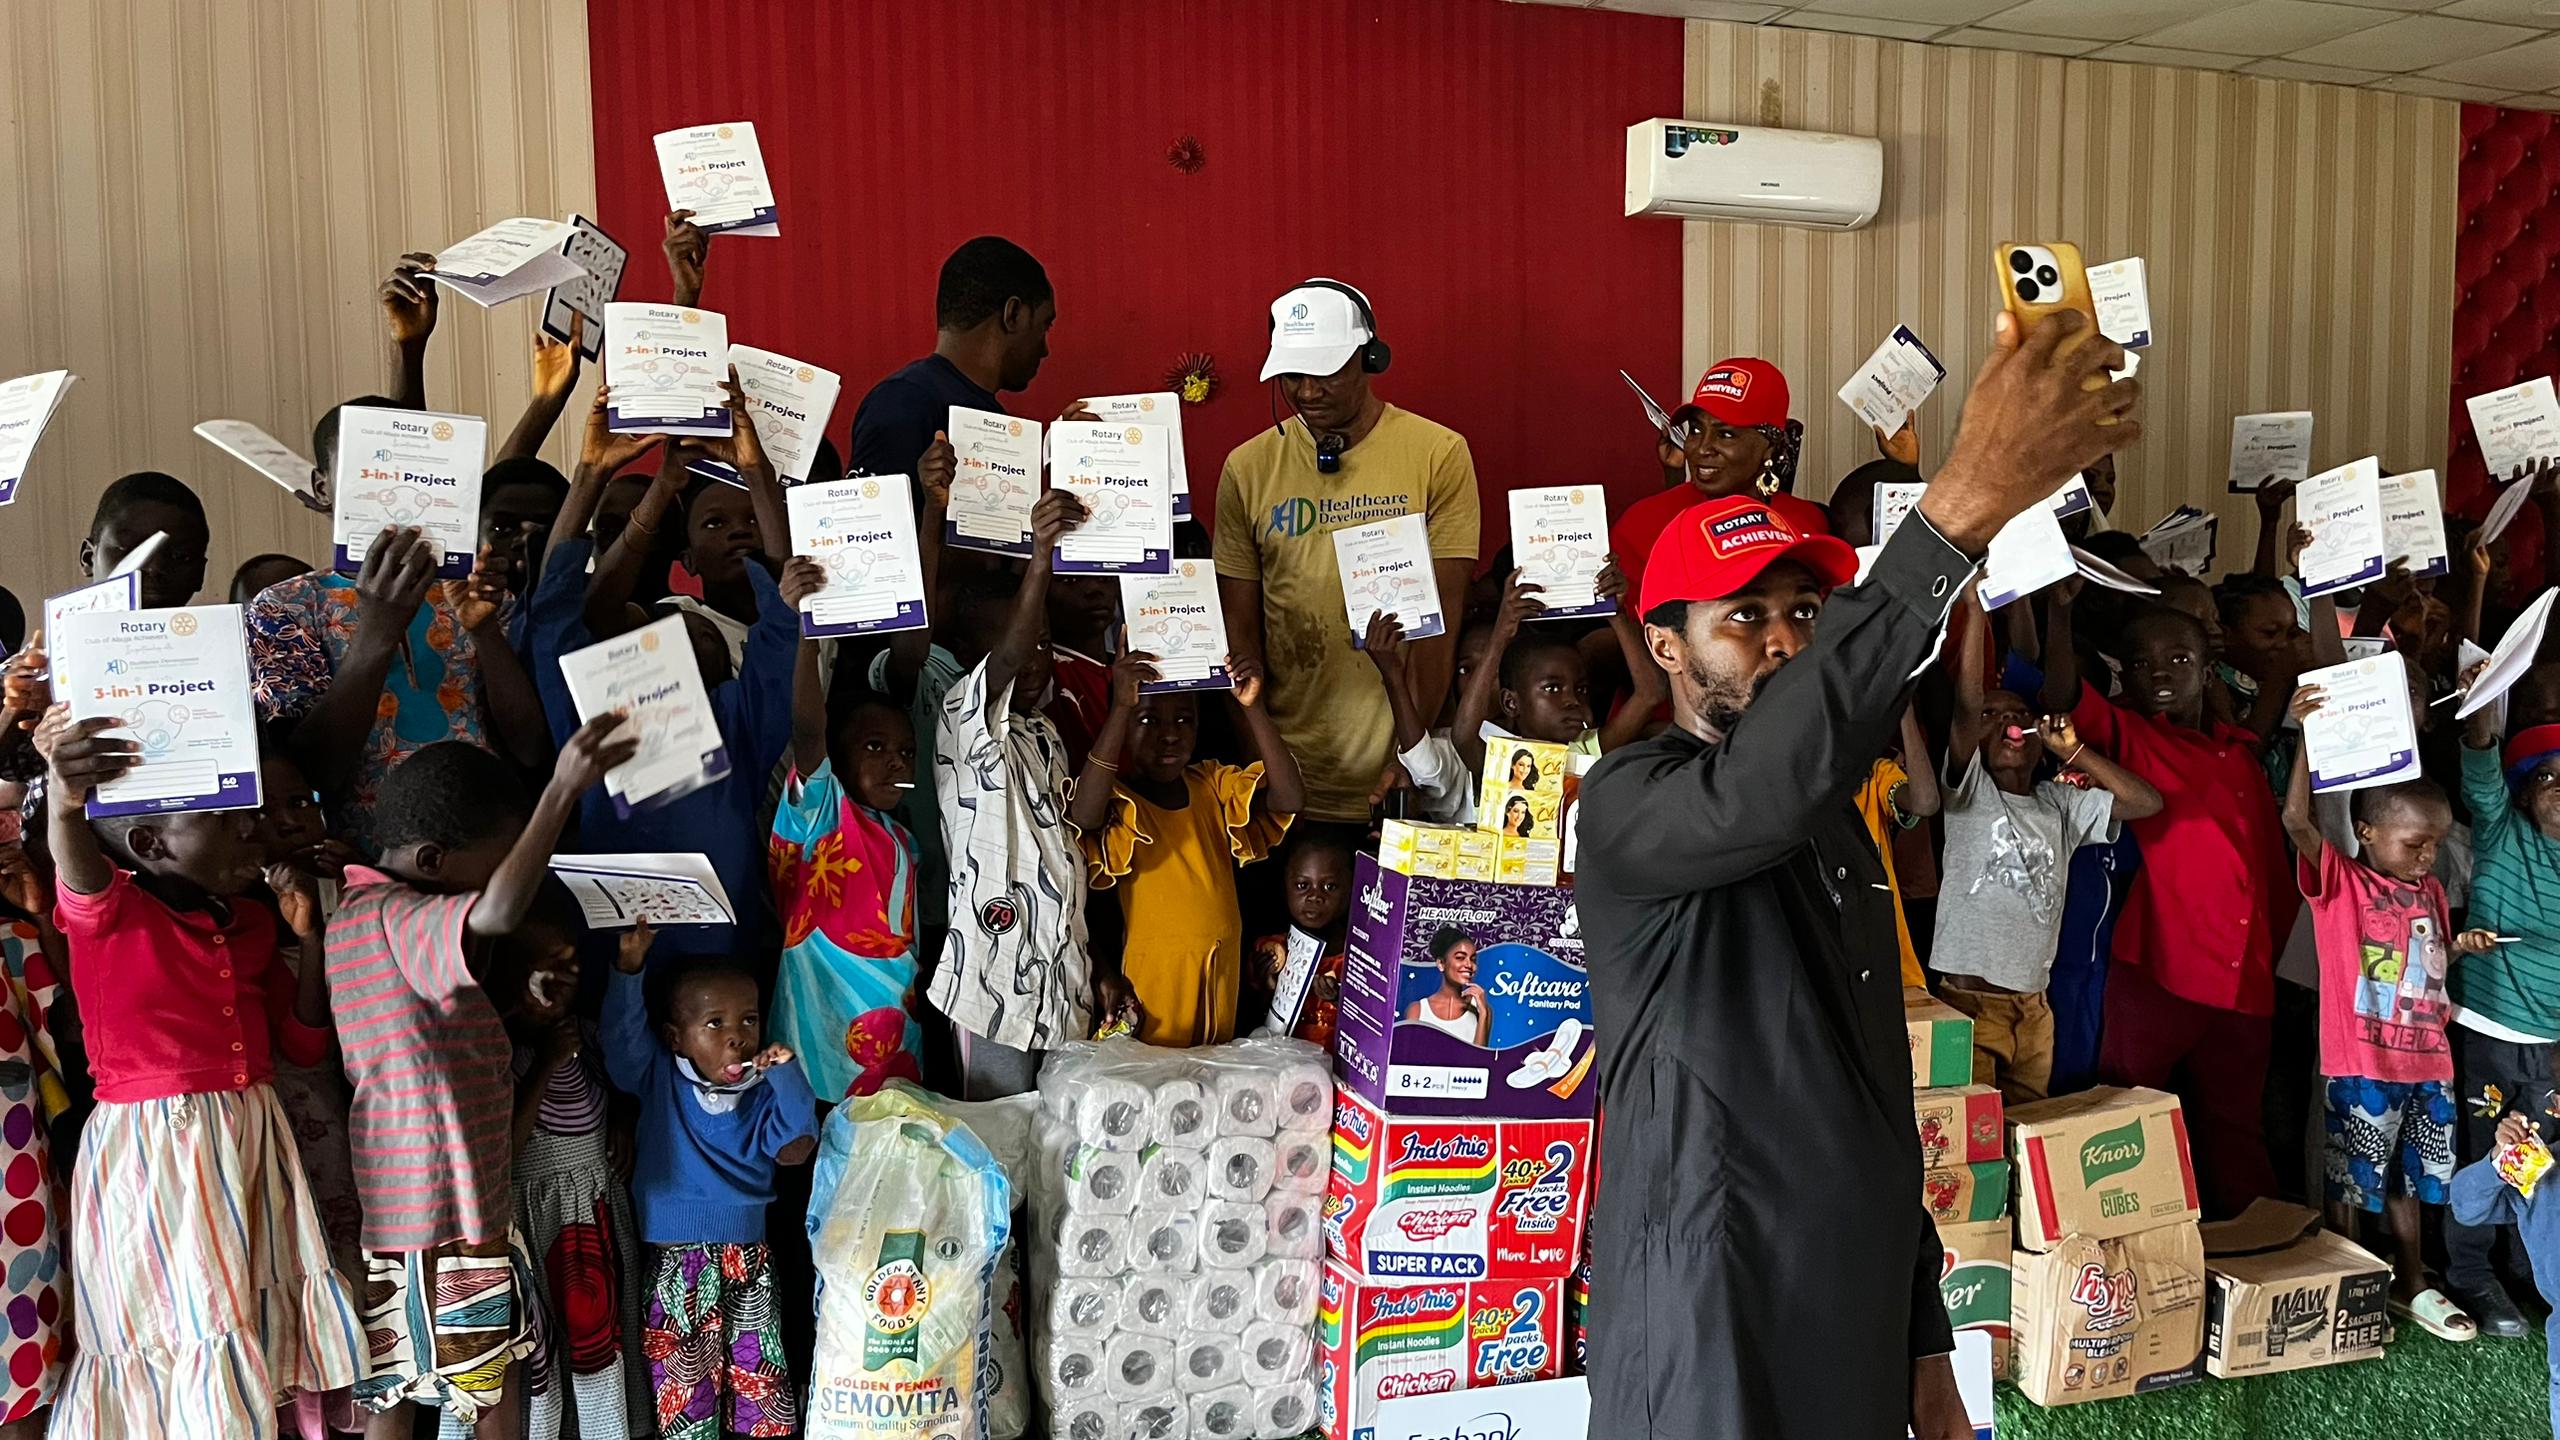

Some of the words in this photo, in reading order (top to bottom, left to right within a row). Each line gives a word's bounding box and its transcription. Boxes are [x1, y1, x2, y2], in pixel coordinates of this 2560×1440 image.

[708, 160, 746, 170] Project
[2104, 292, 2130, 302] Project
[648, 309, 679, 320] Rotary
[625, 346, 658, 355] 3-in-1
[662, 347, 708, 358] Project
[766, 358, 796, 374] Rotary
[1701, 384, 1742, 397] ACHIEVERS
[764, 400, 806, 422] Project
[1112, 402, 1137, 411] Rotary
[393, 421, 429, 434] Rotary
[984, 418, 1006, 431] Rotary
[2513, 415, 2544, 428] Project
[1092, 430, 1122, 440] Rotary
[963, 457, 989, 470] 3-in-1
[991, 462, 1026, 476] Project
[360, 469, 400, 481] 3-in-1
[404, 472, 456, 486] Project
[1068, 475, 1101, 486] 3-in-1
[1104, 476, 1148, 488] Project
[828, 489, 859, 498] Rotary
[1319, 493, 1408, 513] Healthcare
[1319, 507, 1408, 525] Development
[2332, 504, 2364, 520] Project
[2392, 510, 2424, 521] Project
[1715, 514, 1763, 533] ROTARY
[810, 536, 843, 547] 3-in-1
[847, 531, 893, 543] Project
[1362, 529, 1385, 538] Rotary
[1528, 534, 1555, 544] 3-in-1
[1558, 532, 1592, 542] Project
[1378, 560, 1414, 574] Project
[1139, 606, 1167, 616] 3-in-1
[1170, 605, 1205, 615] Project
[120, 622, 166, 633] Rotary
[94, 684, 143, 699] 3-in-1
[148, 679, 215, 695] Project
[2348, 698, 2386, 712] Project
[988, 904, 1012, 926] 79
[1419, 907, 1460, 920] HEAVY
[1461, 910, 1495, 922] FLOW
[1549, 938, 1581, 947] COTTON
[1489, 971, 1582, 1003] Softcare
[1528, 999, 1562, 1010] Sanitary
[1564, 999, 1580, 1010] Pad
[1388, 1131, 1488, 1168] Indomie
[2083, 1142, 2142, 1167] Knorr
[1538, 1144, 1572, 1184] 2
[1408, 1184, 1436, 1194] Instant
[1438, 1184, 1471, 1192] Noodles
[1532, 1183, 1564, 1194] packs
[1333, 1197, 1354, 1224] 2
[1500, 1192, 1567, 1214] Free
[2101, 1192, 2140, 1218] CUBES
[1400, 1210, 1476, 1226] Chicken
[1518, 1217, 1555, 1230] Inside
[1497, 1249, 1526, 1262] More
[1377, 1254, 1429, 1272] SUPER
[1432, 1257, 1478, 1274] PACK
[865, 1265, 901, 1301] GOLDEN
[906, 1264, 926, 1304] PENNY
[2075, 1264, 2136, 1312] hypo
[1361, 1288, 1454, 1330] Indomie
[1509, 1291, 1542, 1334] 2
[2272, 1285, 2332, 1325] WAW
[872, 1314, 914, 1330] FOODS
[1472, 1310, 1512, 1326] 40+
[2336, 1310, 2348, 1329] 2
[2348, 1312, 2382, 1327] SACHETS
[1474, 1327, 1500, 1335] packs
[1505, 1332, 1539, 1346] packs
[2336, 1325, 2381, 1348] FREE
[1378, 1338, 1405, 1350] Instant
[1407, 1336, 1440, 1348] Noodles
[1478, 1342, 1545, 1373] Free
[2086, 1346, 2119, 1358] BLEACH
[834, 1376, 893, 1390] GOLDEN
[895, 1377, 943, 1392] PENNY
[1379, 1372, 1452, 1397] Chicken
[820, 1387, 959, 1418] SEMOVITA
[866, 1419, 906, 1432] Quality
[909, 1412, 960, 1428] Semolina
